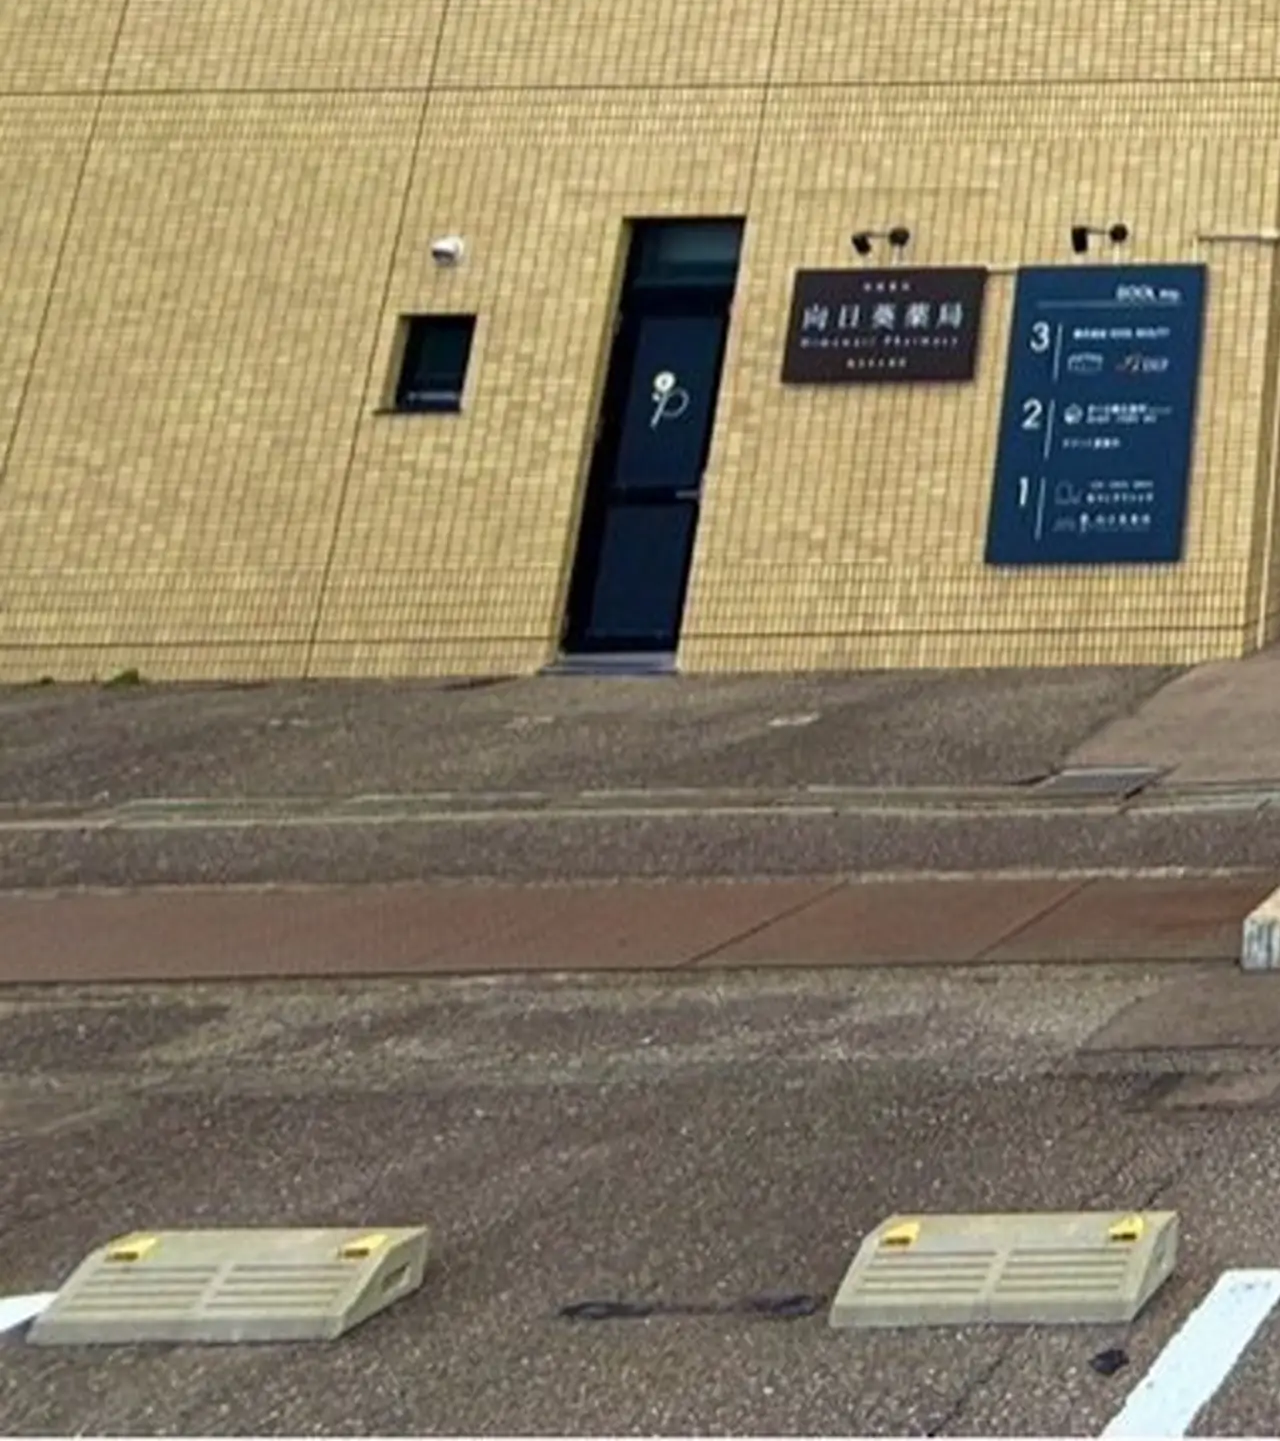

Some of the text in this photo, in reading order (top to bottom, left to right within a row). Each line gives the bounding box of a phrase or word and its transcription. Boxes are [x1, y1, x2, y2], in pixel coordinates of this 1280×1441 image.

[1030, 320, 1050, 353] 3
[1022, 397, 1043, 430] 2
[1019, 476, 1029, 506] 1
